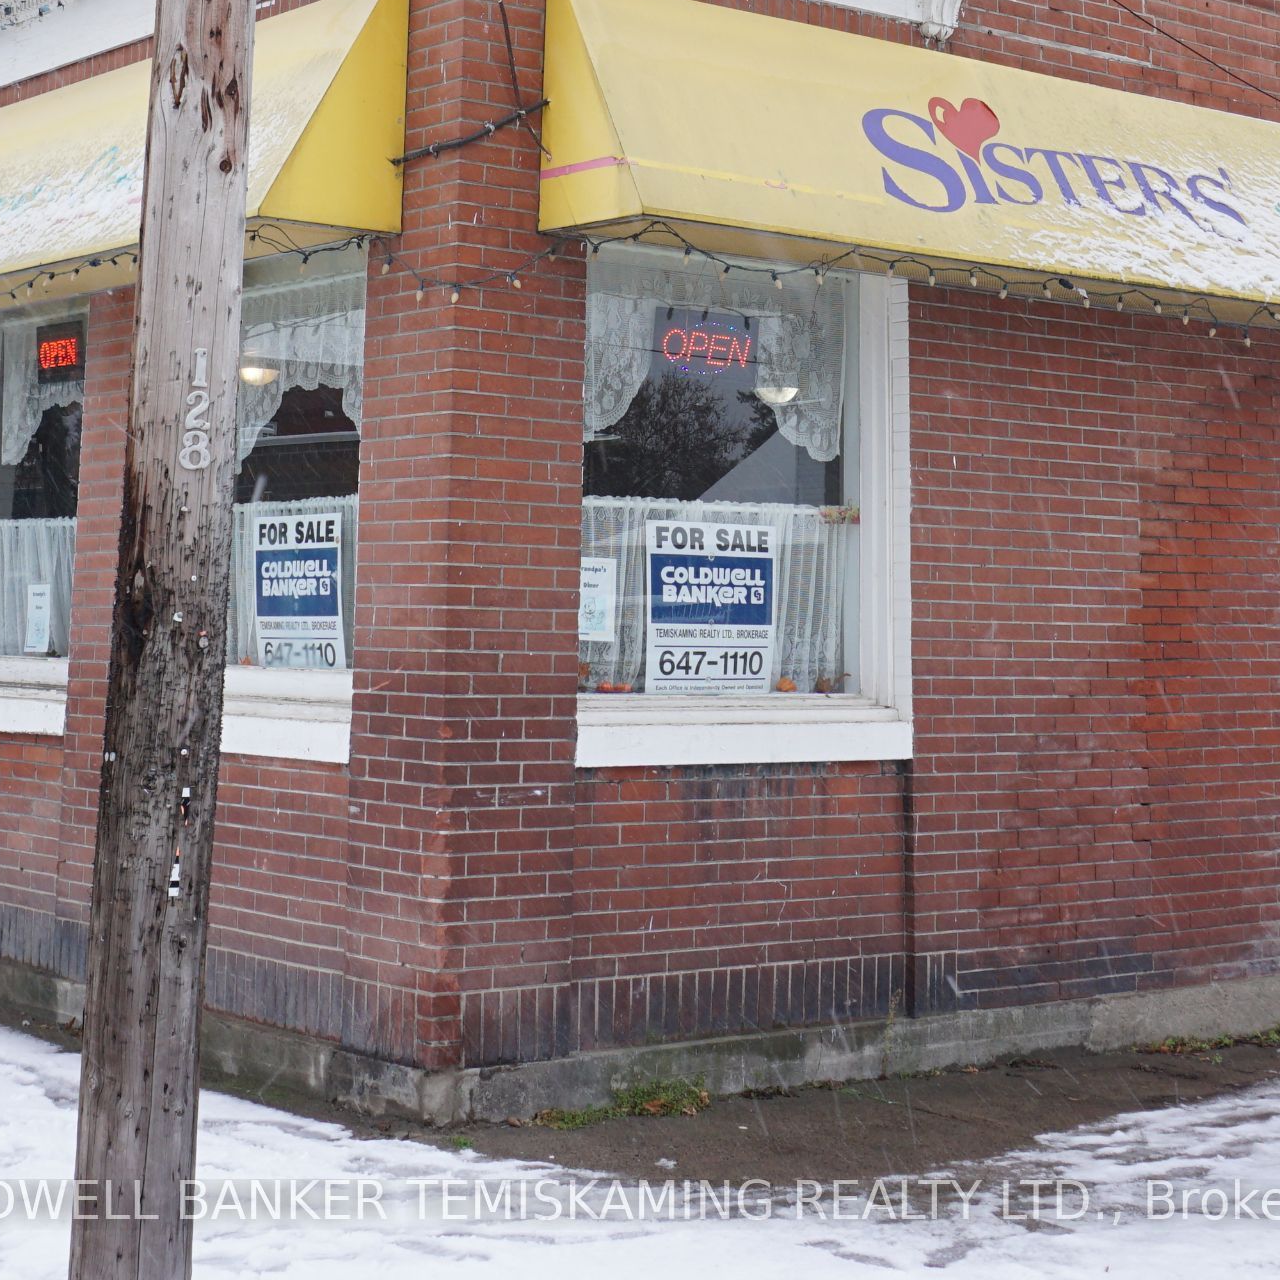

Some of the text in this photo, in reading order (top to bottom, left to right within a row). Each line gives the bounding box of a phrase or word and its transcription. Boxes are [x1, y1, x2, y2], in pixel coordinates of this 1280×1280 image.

[39, 338, 77, 369] OPEN
[662, 328, 752, 369] OPEN
[178, 347, 211, 470] 128
[259, 520, 336, 545] FOR SALE
[655, 525, 769, 553] FOR SALE
[261, 559, 332, 579] COLDWELL
[581, 565, 607, 574] randpa's
[660, 565, 766, 586] COLDWELL
[262, 578, 317, 599] BANKER
[662, 584, 748, 607] BANKER
[655, 628, 698, 639] TEMISKAMING
[699, 628, 721, 639] REALTY
[736, 629, 769, 640] BROKERAGE
[659, 650, 764, 676] 647-1110
